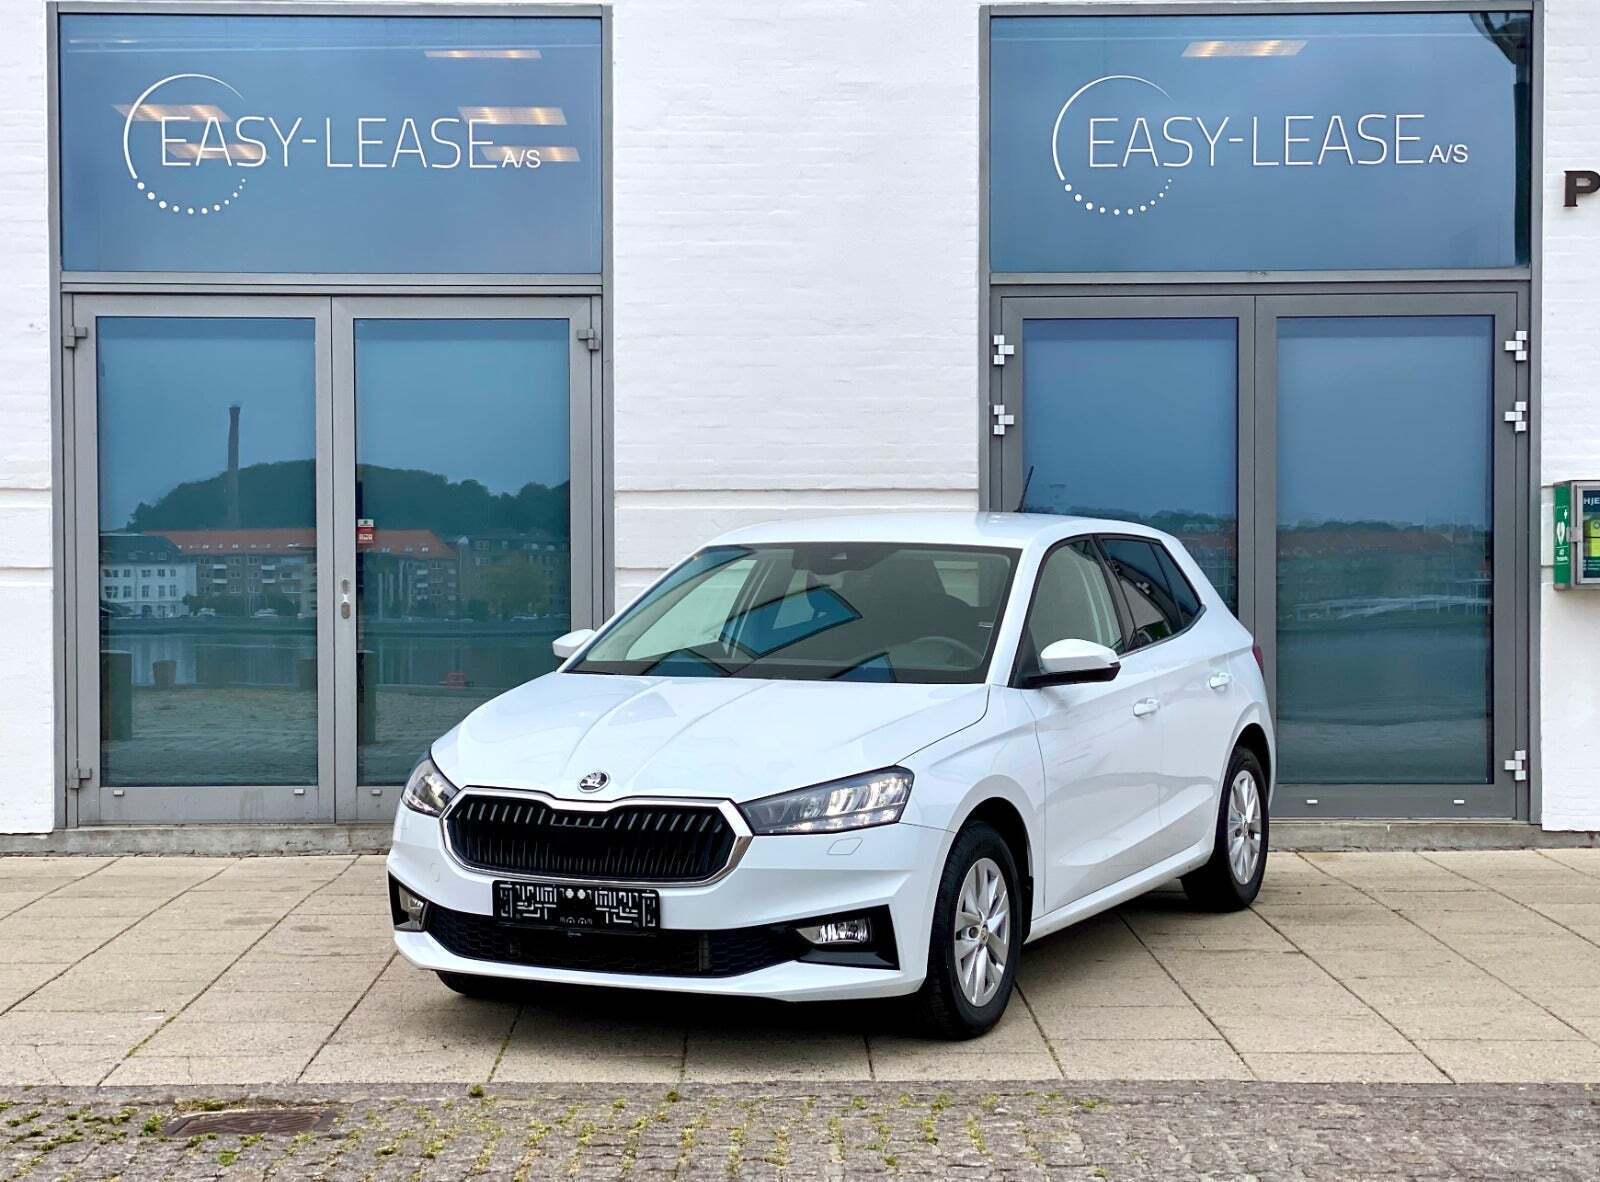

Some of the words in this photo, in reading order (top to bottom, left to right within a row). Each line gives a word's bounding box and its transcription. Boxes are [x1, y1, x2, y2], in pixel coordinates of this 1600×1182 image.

[161, 116, 498, 168] EASY-LEASE
[501, 148, 541, 168] A/S
[1089, 114, 1426, 168] EASY-LEASE
[1429, 144, 1469, 164] A/S
